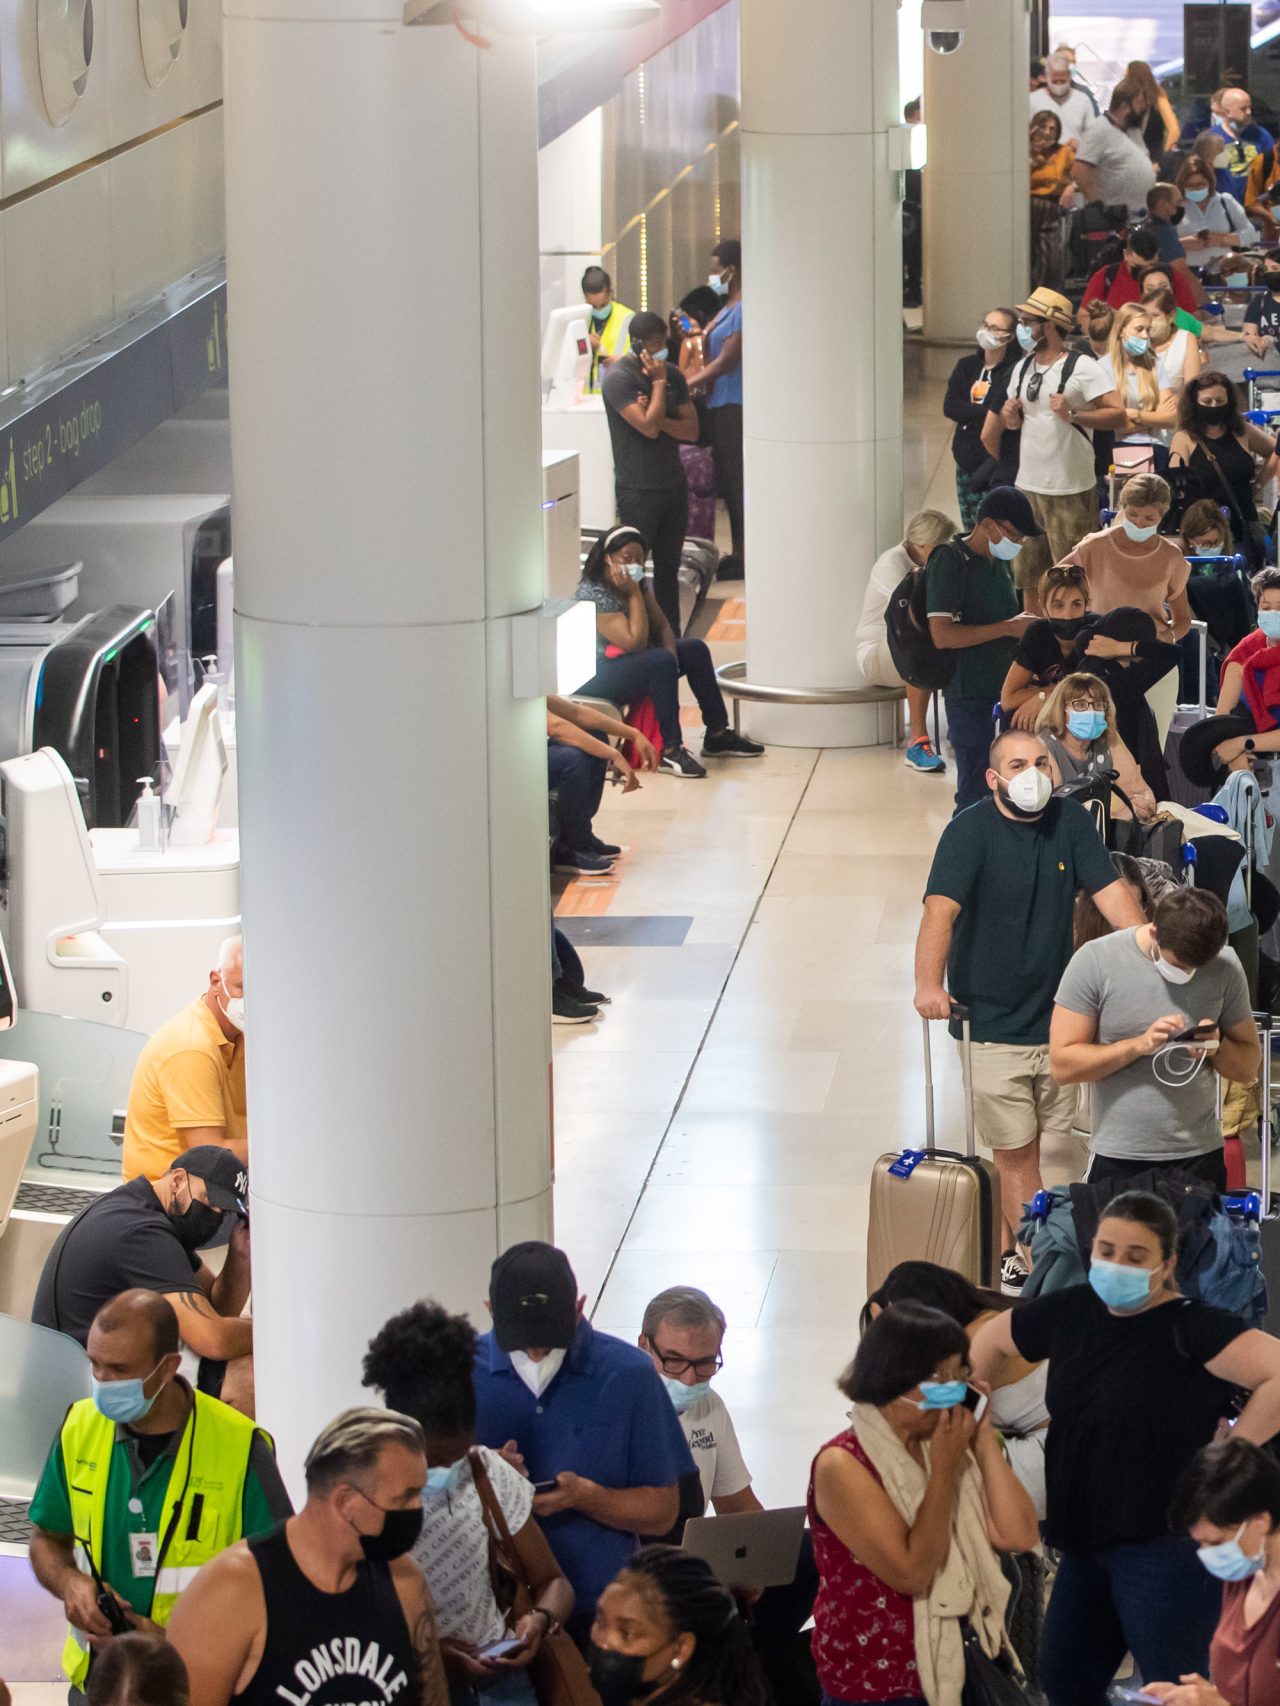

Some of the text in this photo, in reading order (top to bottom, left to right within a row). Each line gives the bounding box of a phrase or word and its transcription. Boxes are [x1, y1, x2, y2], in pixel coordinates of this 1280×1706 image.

[23, 440, 45, 481] step
[45, 424, 53, 465] 2
[59, 415, 79, 457] bag
[275, 1636, 409, 1706] LONSDALE
